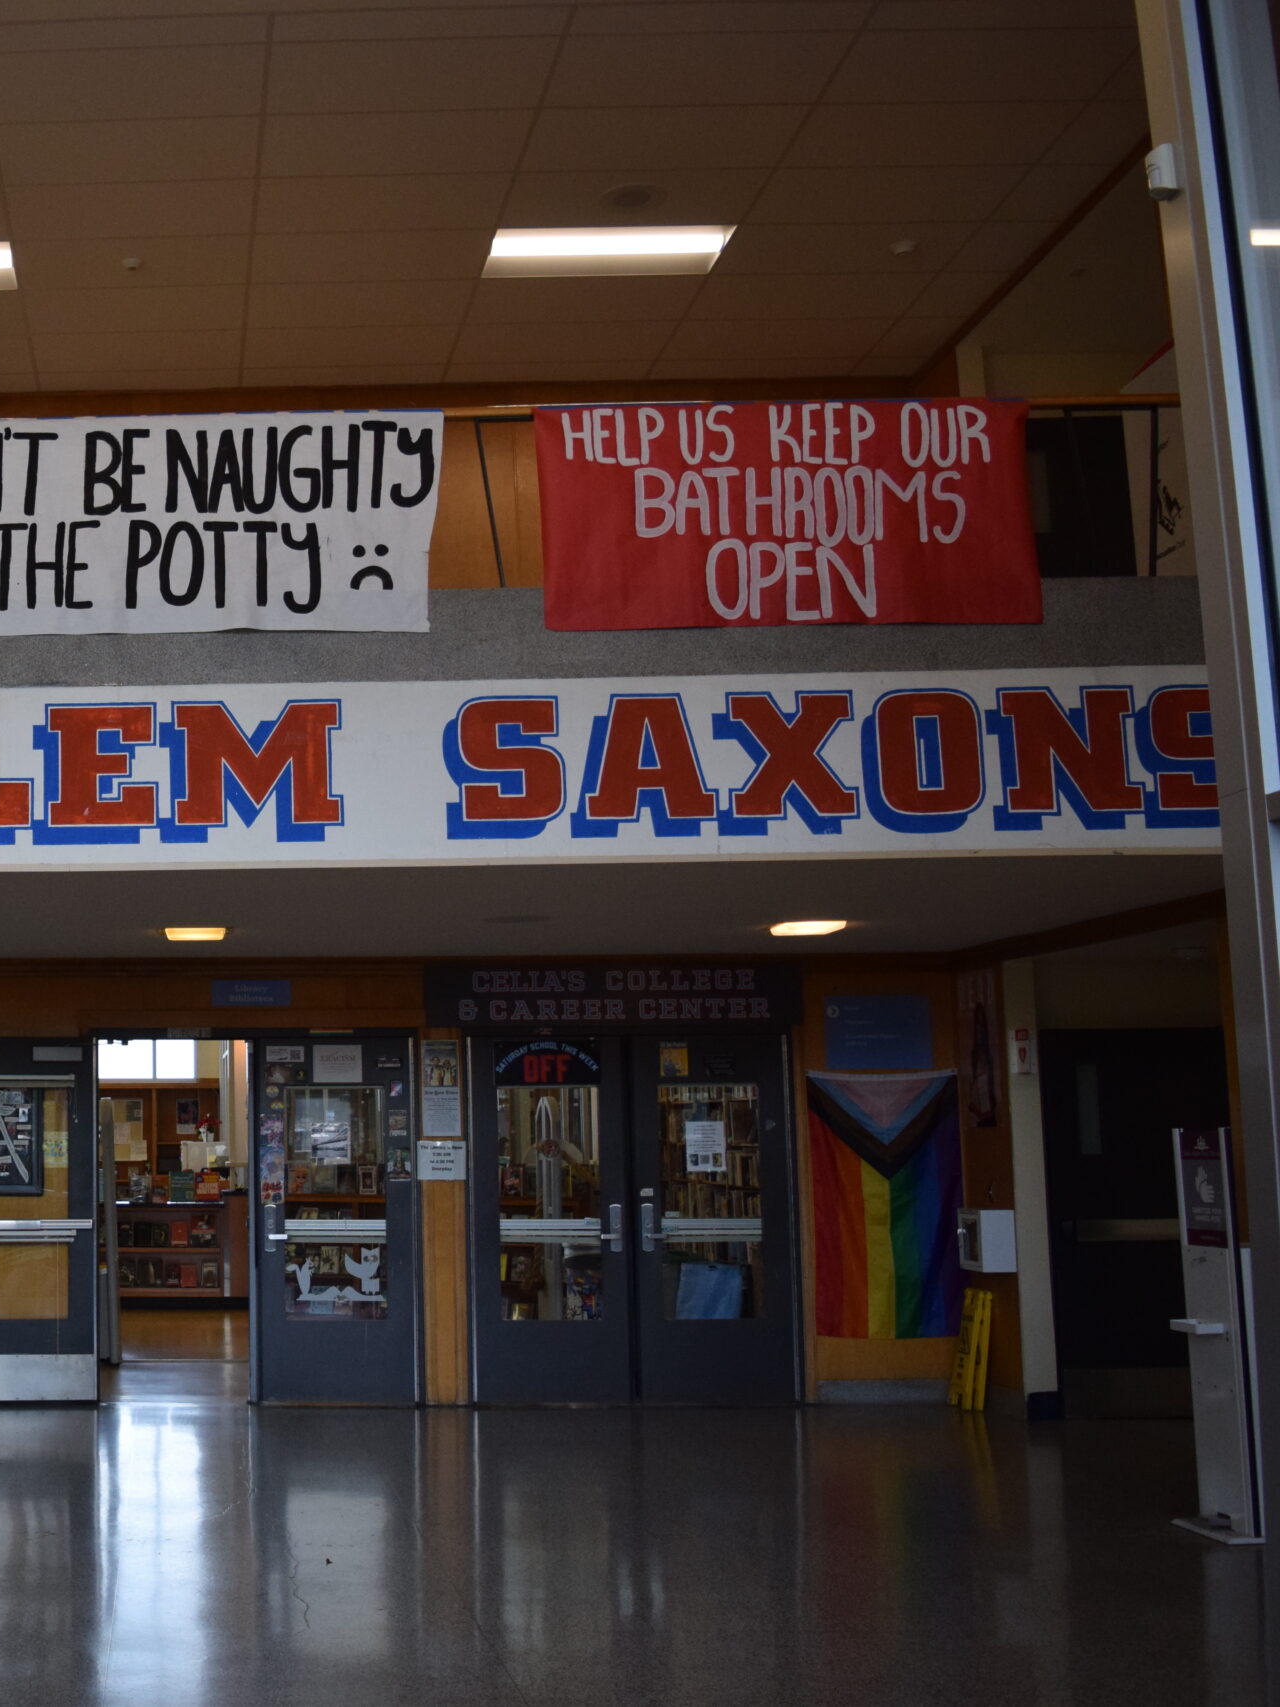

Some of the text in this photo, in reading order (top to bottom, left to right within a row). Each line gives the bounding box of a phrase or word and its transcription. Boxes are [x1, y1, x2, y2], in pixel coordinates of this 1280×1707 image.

[85, 428, 151, 515] BE
[166, 420, 435, 514] NAUGHTY
[562, 401, 991, 469] HELP US KEEP OUR
[634, 464, 966, 548] BATHROOMS
[125, 518, 320, 614] POTTY
[706, 538, 878, 621] OPEN
[442, 684, 1221, 840] SAXONS
[234, 984, 268, 994] Library
[458, 998, 771, 1020] & CAREER CENTER
[471, 969, 756, 993] CELIA'S COLLEGE
[496, 1045, 528, 1073] SATURDAY
[530, 1041, 559, 1051] SCHOOL
[523, 1054, 573, 1083] OFF
